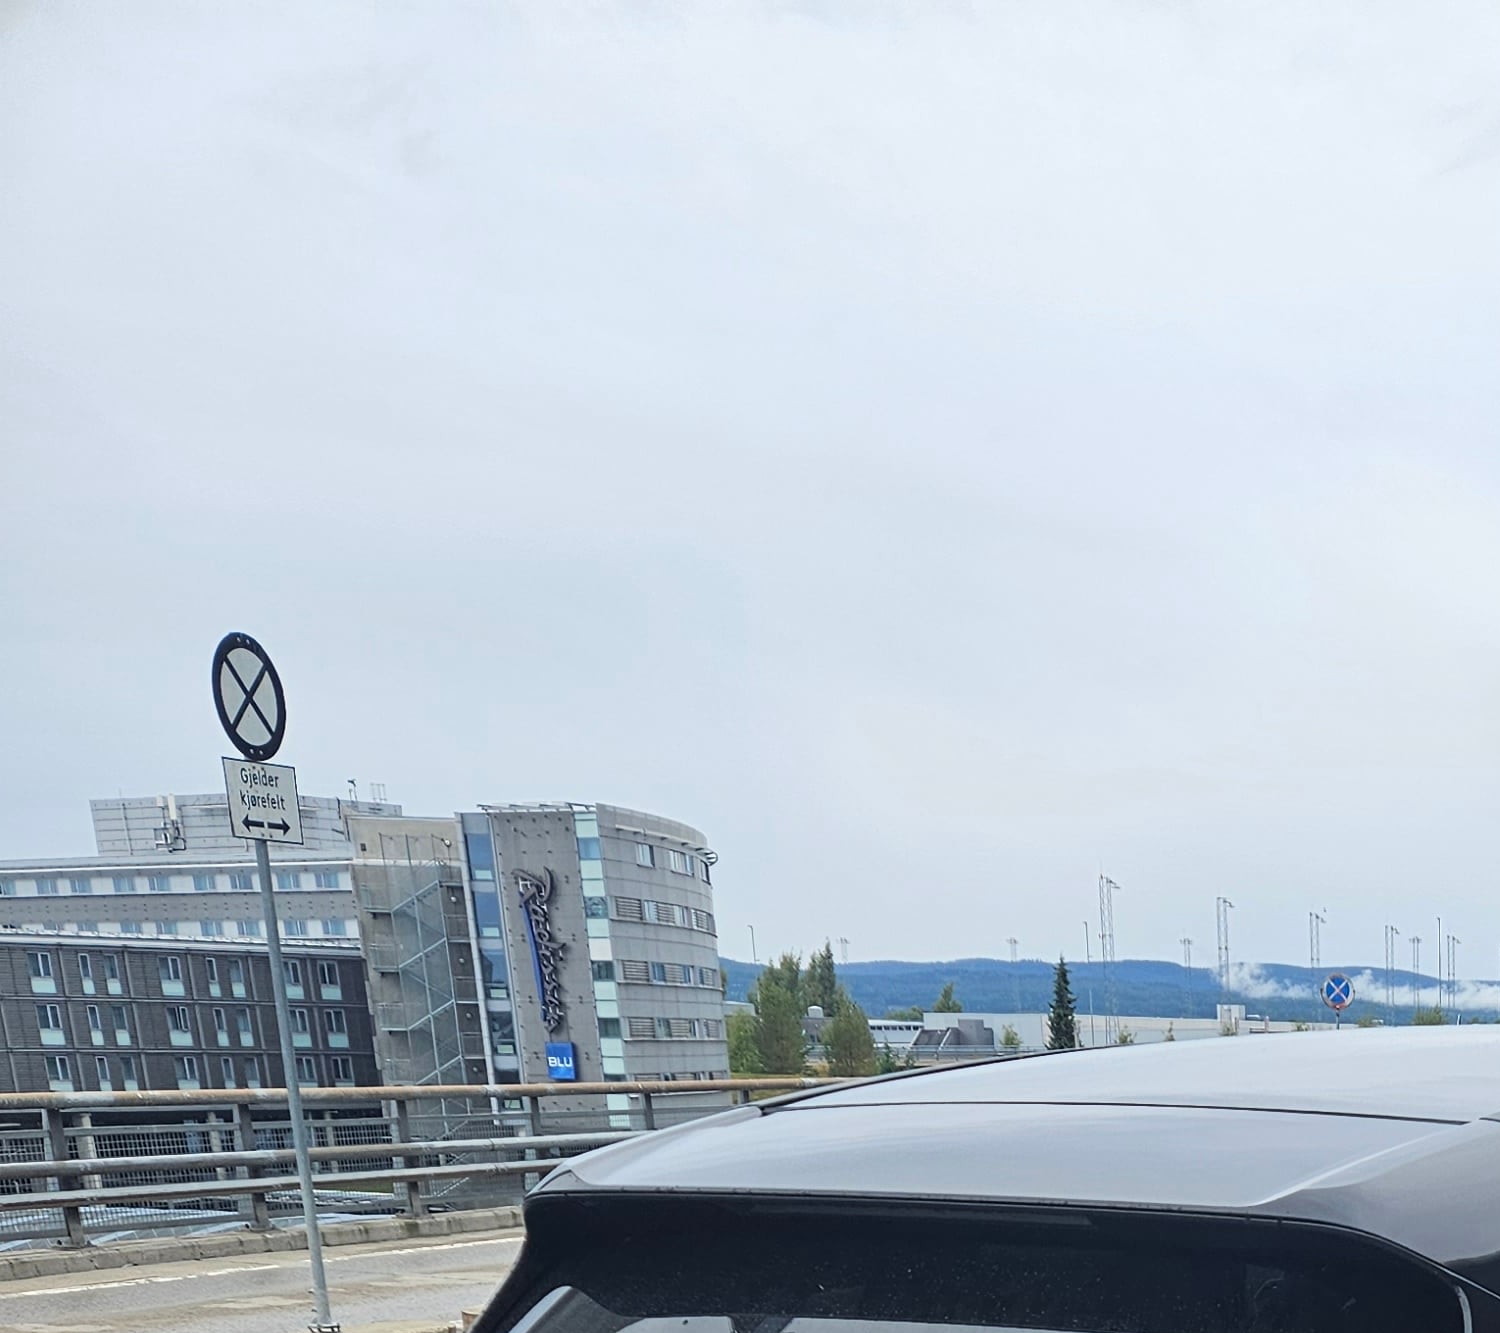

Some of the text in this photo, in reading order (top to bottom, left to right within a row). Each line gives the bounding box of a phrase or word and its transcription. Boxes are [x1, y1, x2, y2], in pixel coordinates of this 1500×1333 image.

[240, 767, 279, 788] Gjelder
[240, 790, 286, 811] kjørefelt
[511, 866, 567, 1033] Radisson
[548, 1056, 573, 1068] BLU
